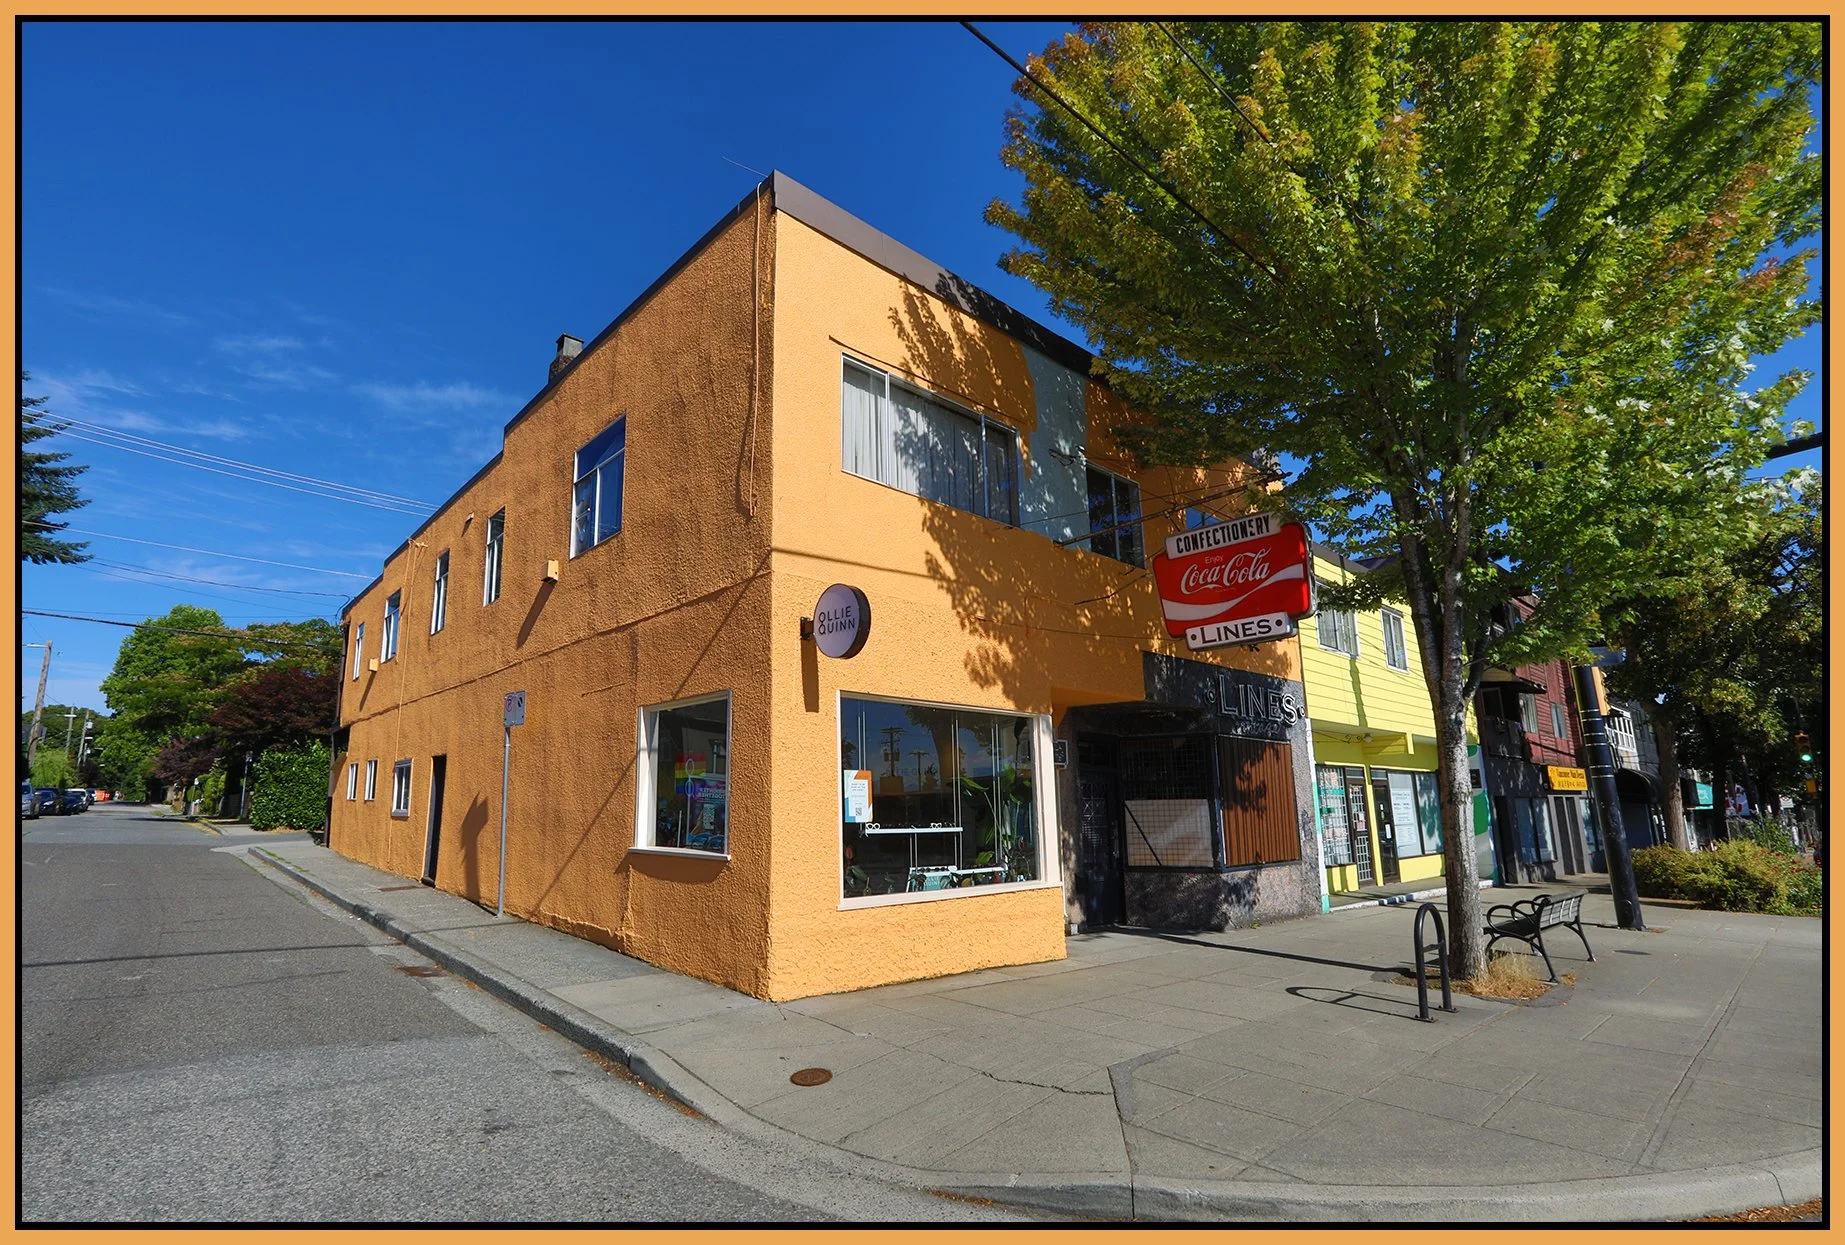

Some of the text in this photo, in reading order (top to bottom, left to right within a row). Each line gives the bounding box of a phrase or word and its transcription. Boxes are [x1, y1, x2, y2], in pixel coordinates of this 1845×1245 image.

[1176, 514, 1271, 554] CONFECTIONERY
[1180, 546, 1272, 595] Coca-Cola
[1204, 554, 1224, 565] Enjoy
[818, 605, 852, 622] OLLIE
[818, 618, 856, 635] QUINN
[1200, 619, 1273, 645] LINES
[1218, 673, 1298, 727] LINES
